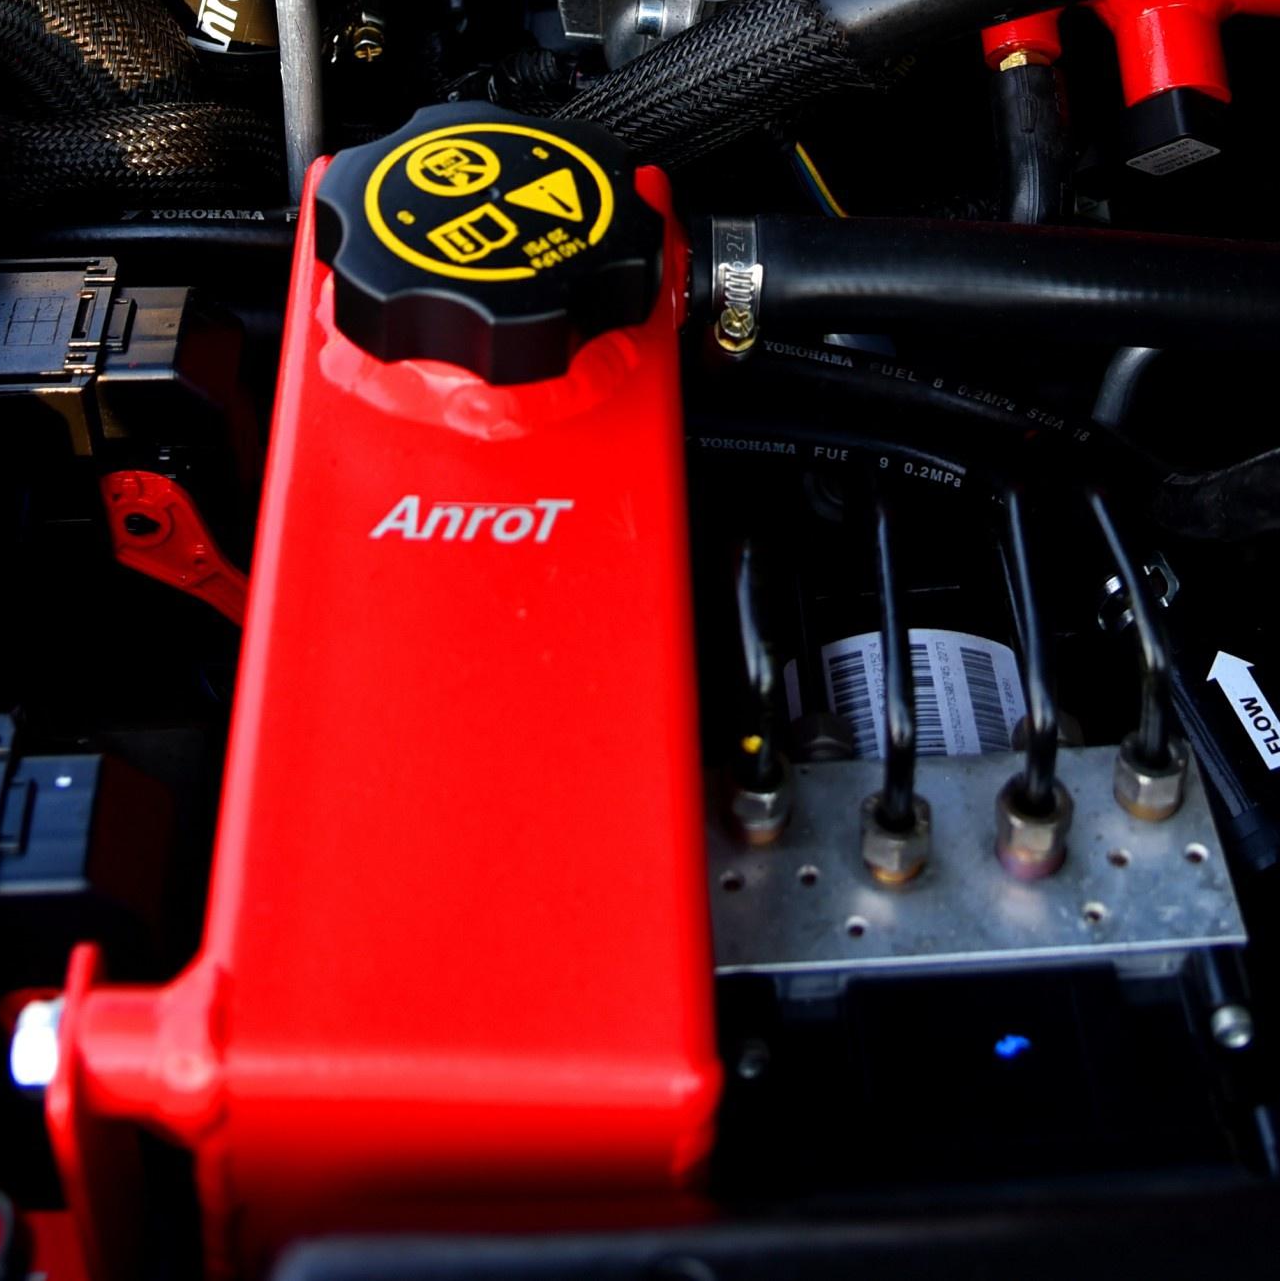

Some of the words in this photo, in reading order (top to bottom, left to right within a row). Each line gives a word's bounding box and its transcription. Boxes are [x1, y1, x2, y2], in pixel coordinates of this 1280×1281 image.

[150, 208, 265, 221] YOKOHAMA
[764, 340, 854, 368] YOKOHAMA
[699, 436, 797, 455] YOKOHAMA
[903, 461, 962, 488] 0.2MPa
[369, 494, 575, 544] AnroT
